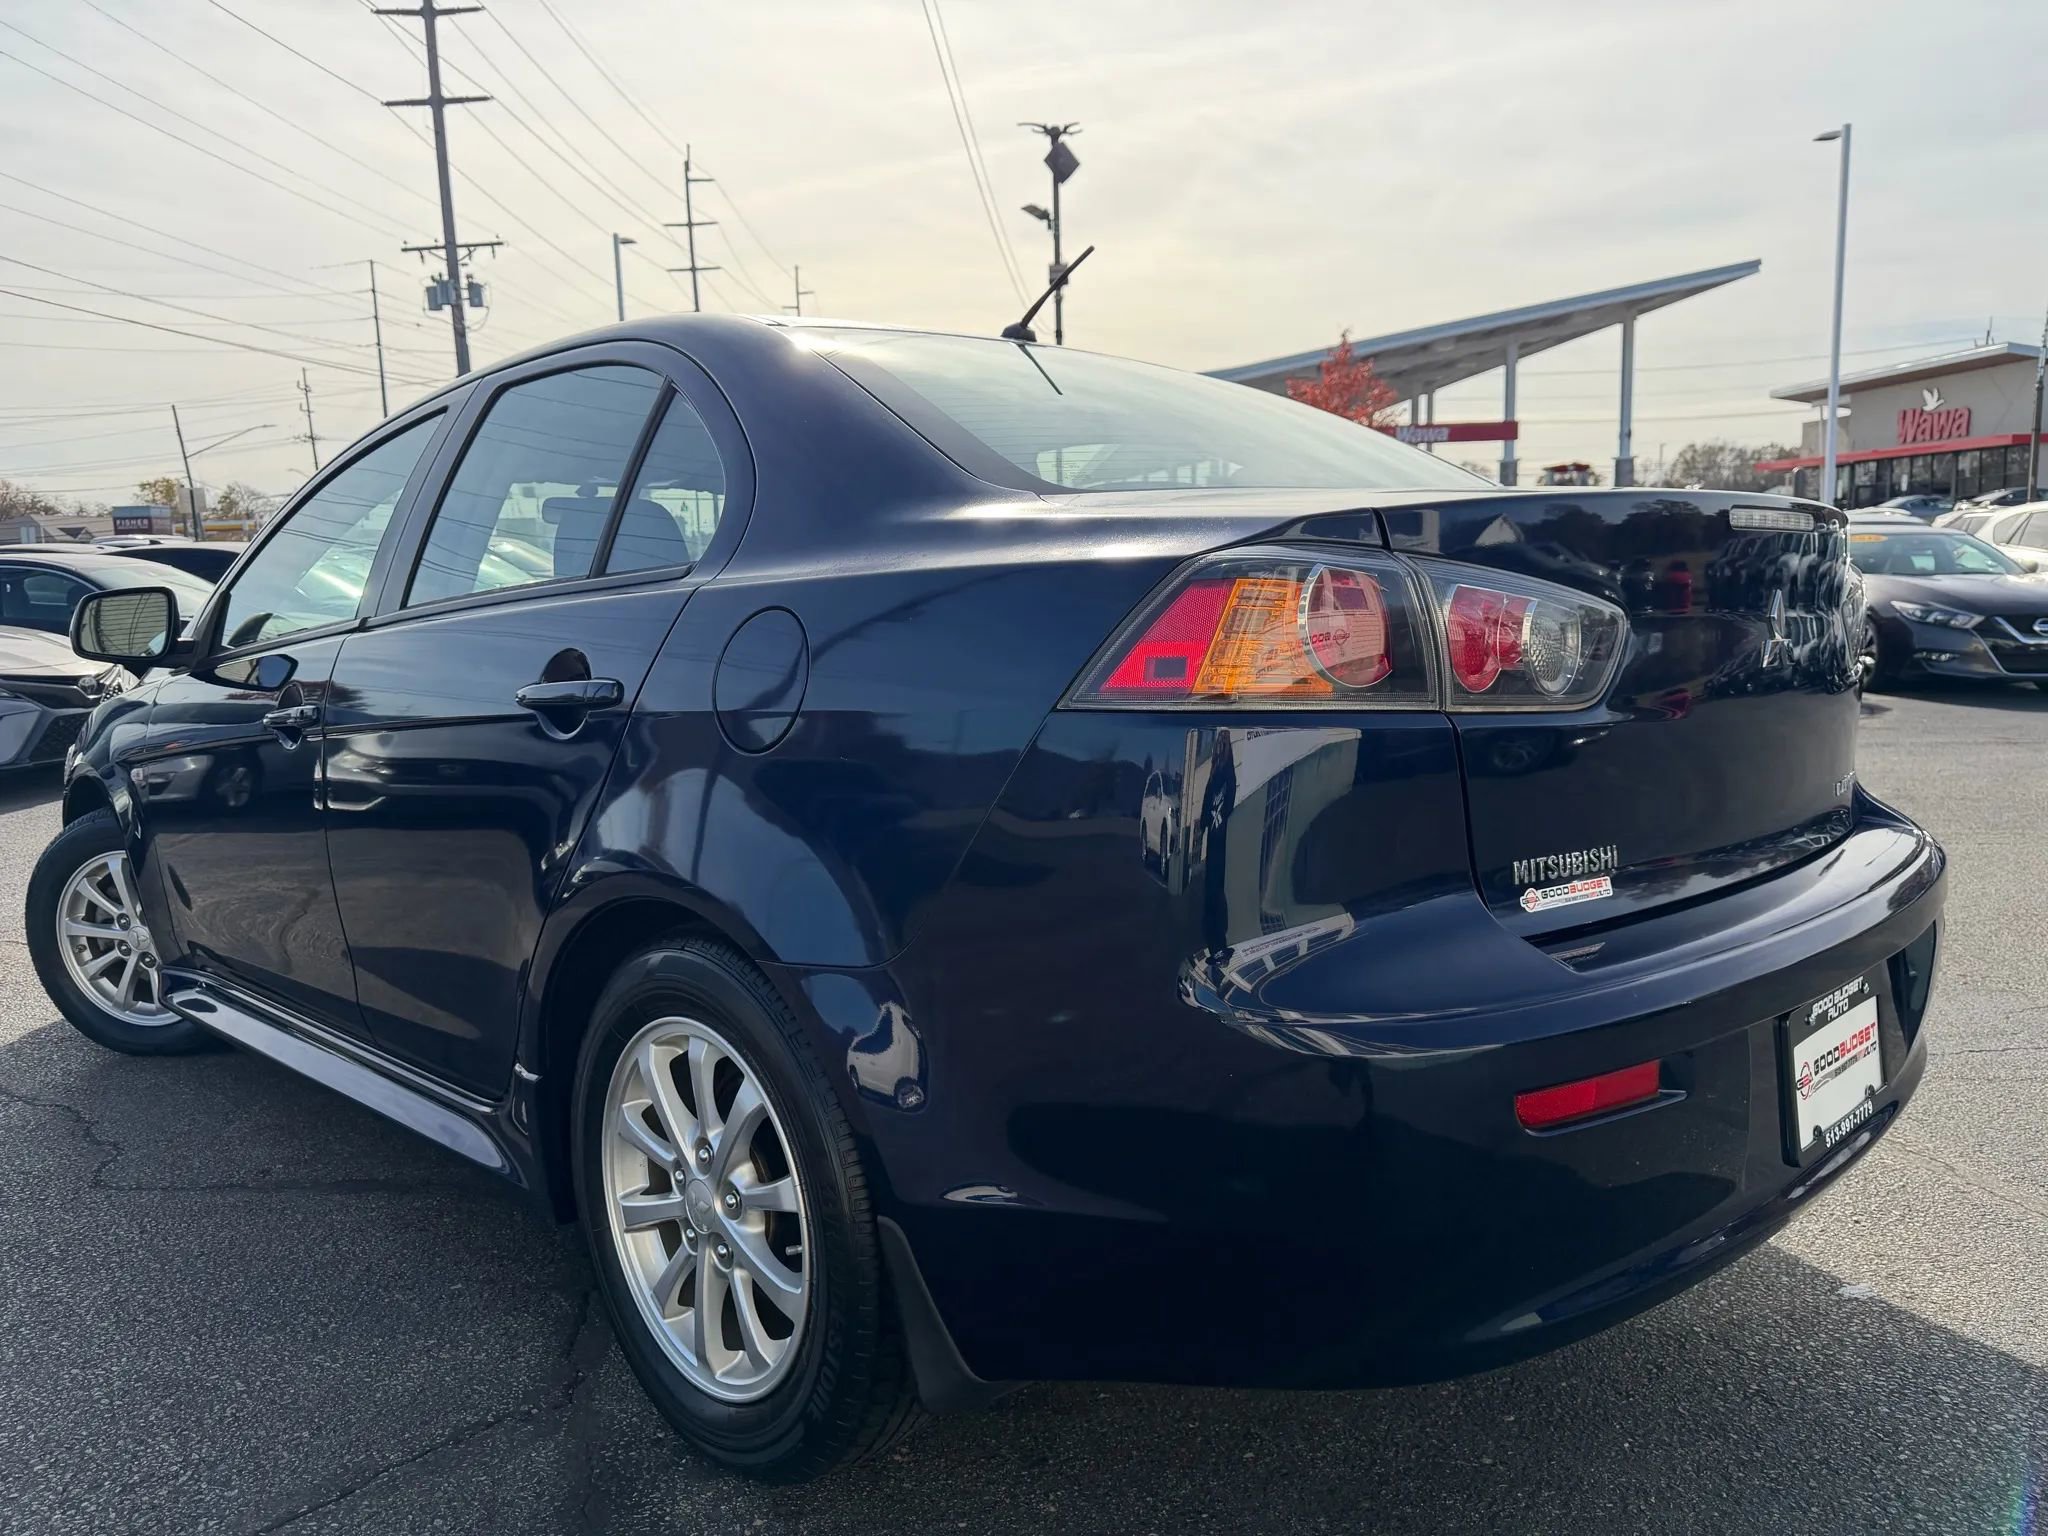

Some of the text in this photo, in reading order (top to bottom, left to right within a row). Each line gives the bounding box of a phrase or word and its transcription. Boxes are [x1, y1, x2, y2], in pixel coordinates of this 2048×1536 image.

[1898, 407, 1970, 444] Wawa
[1512, 845, 1618, 885] MITSUBISHI
[1834, 976, 1864, 1004] BUDGET
[1827, 998, 1849, 1021] AUTO
